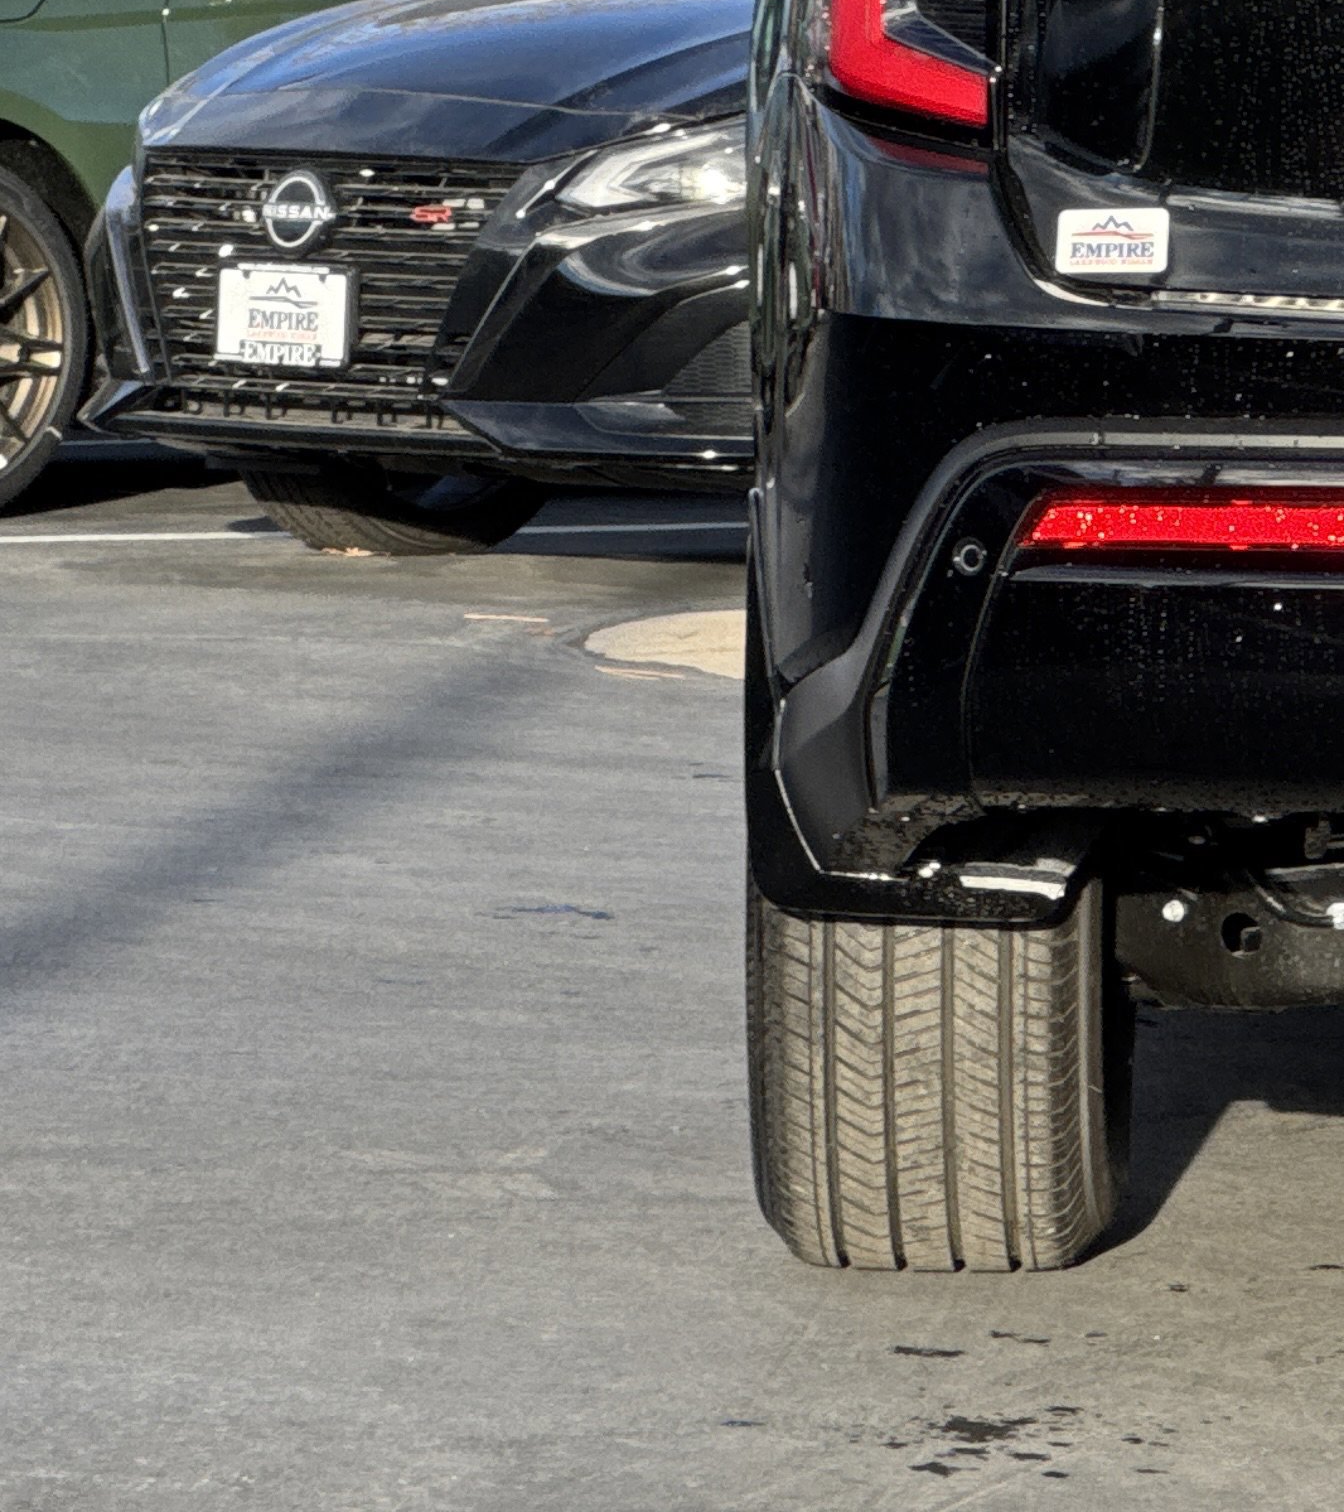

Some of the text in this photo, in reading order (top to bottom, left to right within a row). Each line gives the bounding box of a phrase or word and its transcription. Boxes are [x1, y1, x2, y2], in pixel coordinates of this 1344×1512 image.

[262, 203, 330, 220] NISSAN
[1070, 241, 1155, 258] EMPIRE
[248, 308, 319, 332] EMPIRE
[244, 340, 317, 367] EMPIRE
